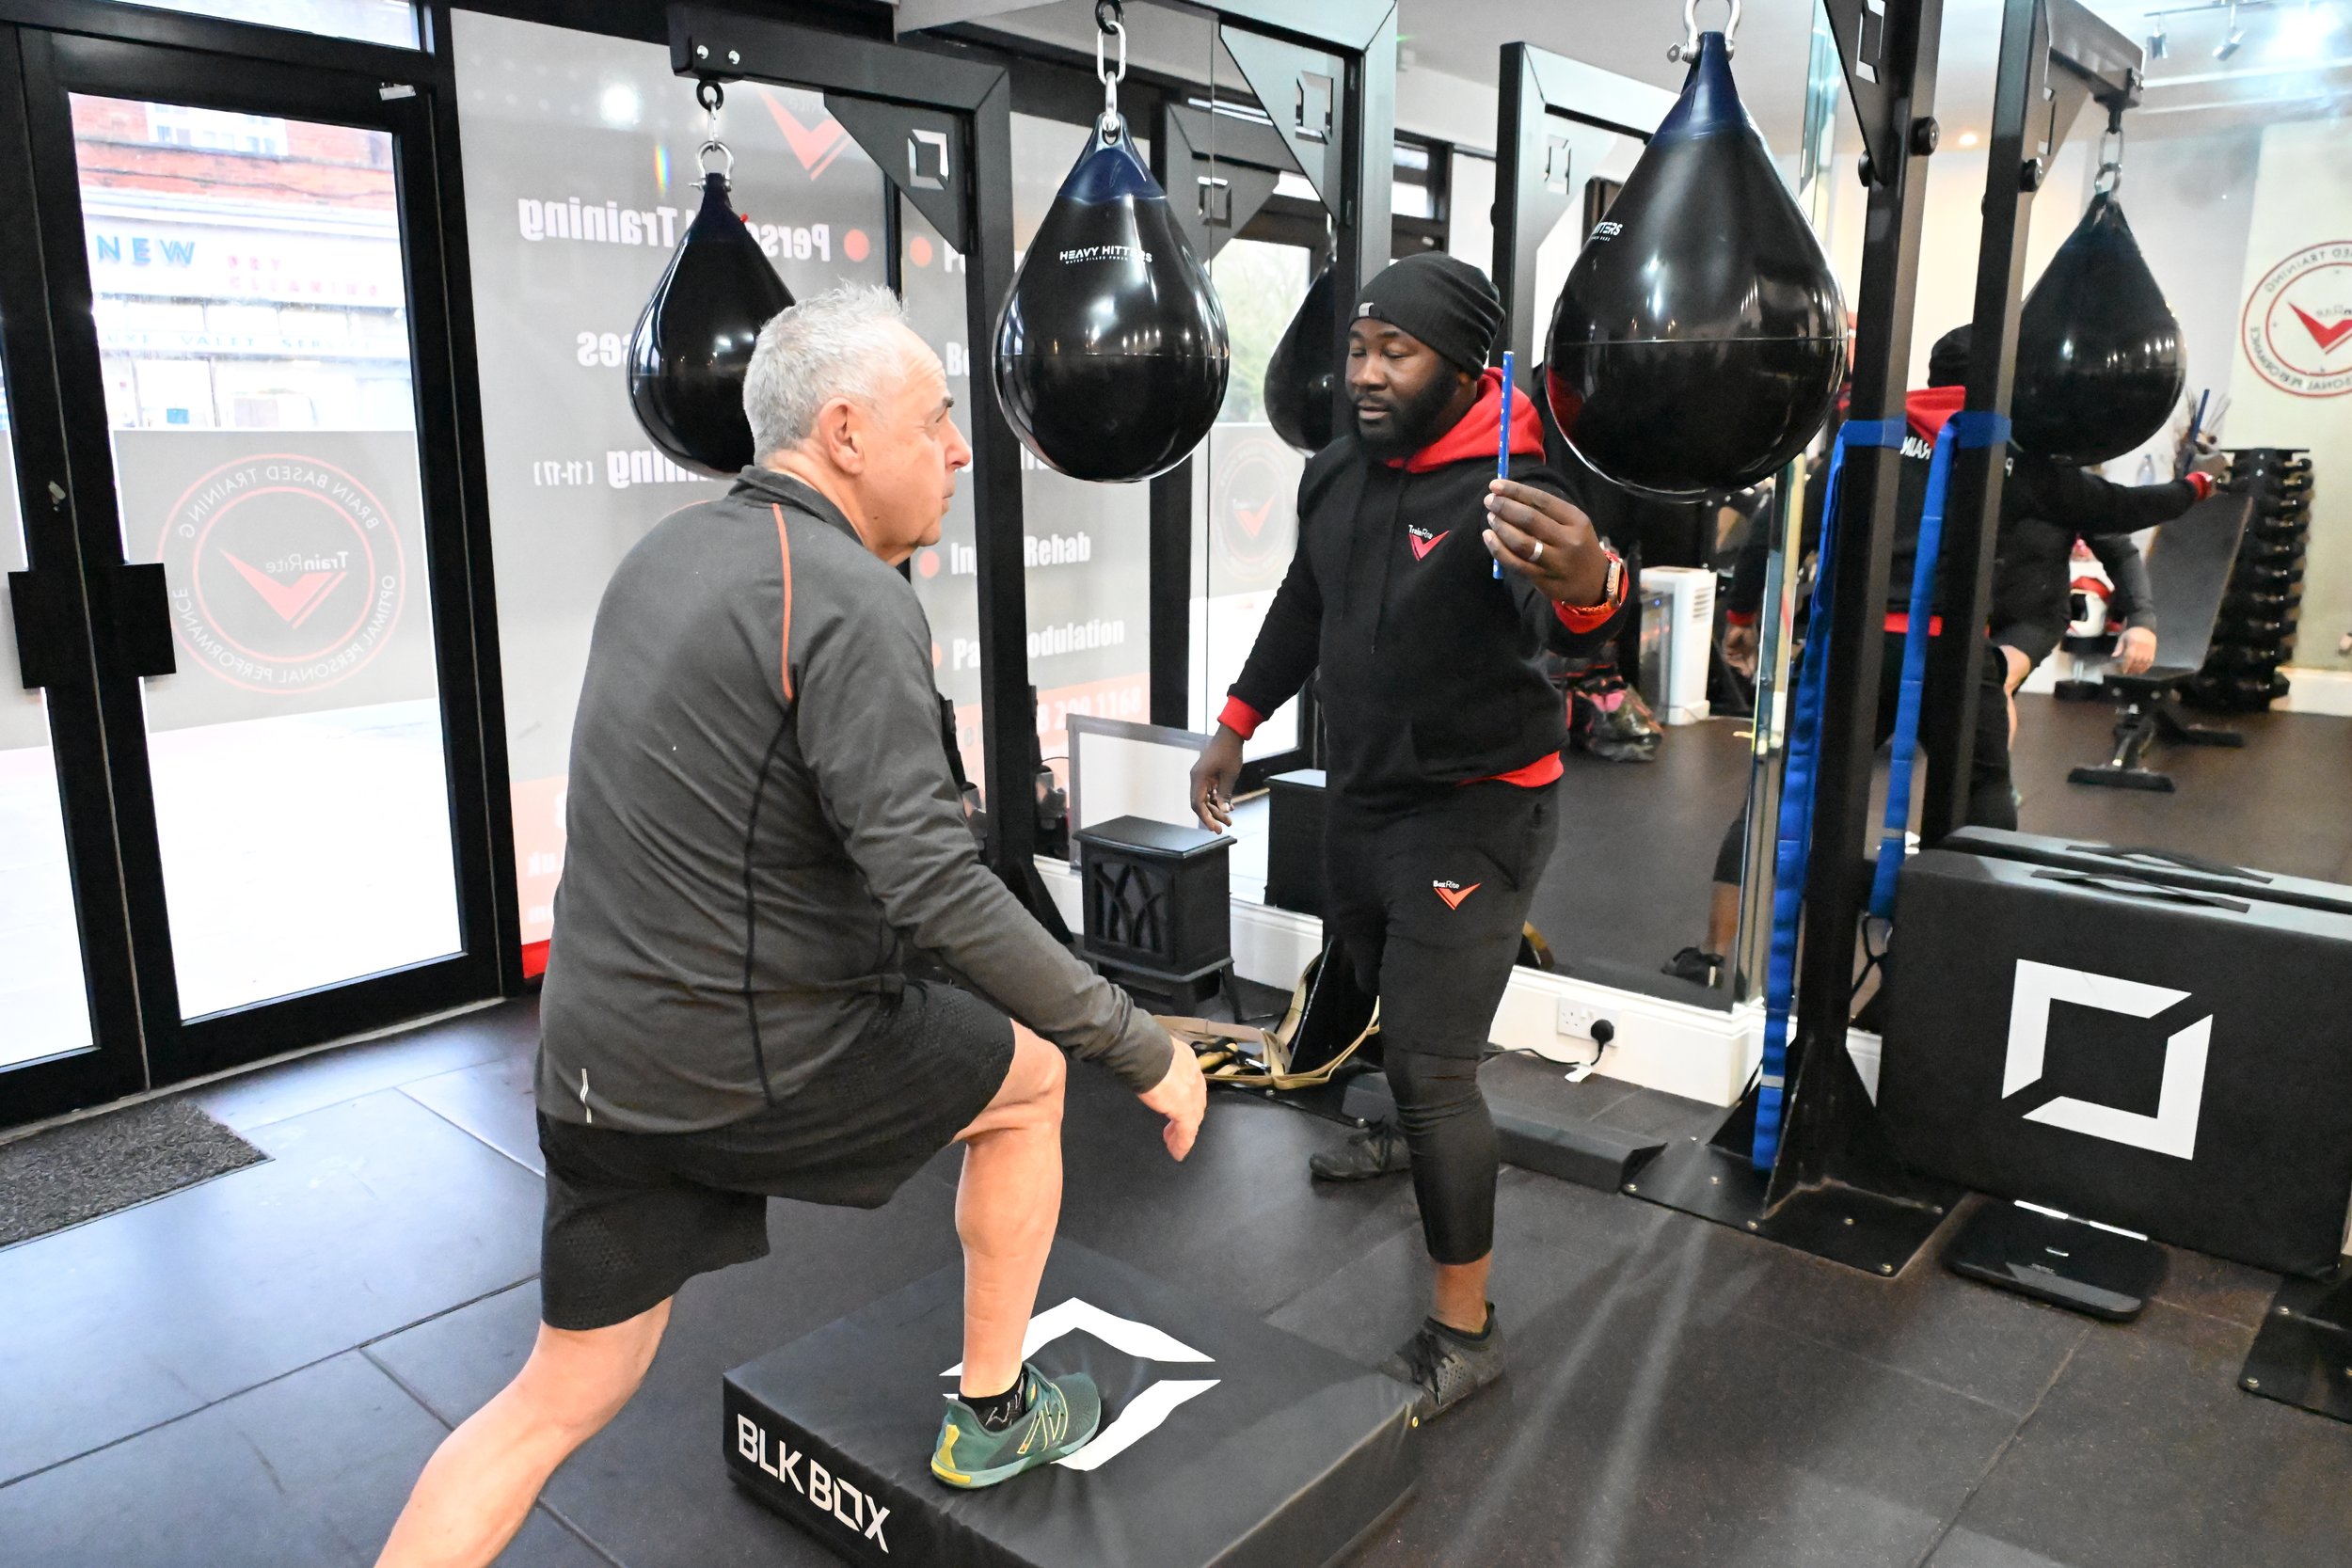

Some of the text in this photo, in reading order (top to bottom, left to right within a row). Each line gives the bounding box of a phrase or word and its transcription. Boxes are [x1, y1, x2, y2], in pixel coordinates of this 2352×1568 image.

[96, 235, 196, 267] NEW
[1059, 246, 1100, 261] HEAVY
[1025, 531, 1091, 568] Rehab
[1027, 619, 1125, 658] odulation
[737, 1413, 891, 1554] BLK BOX
